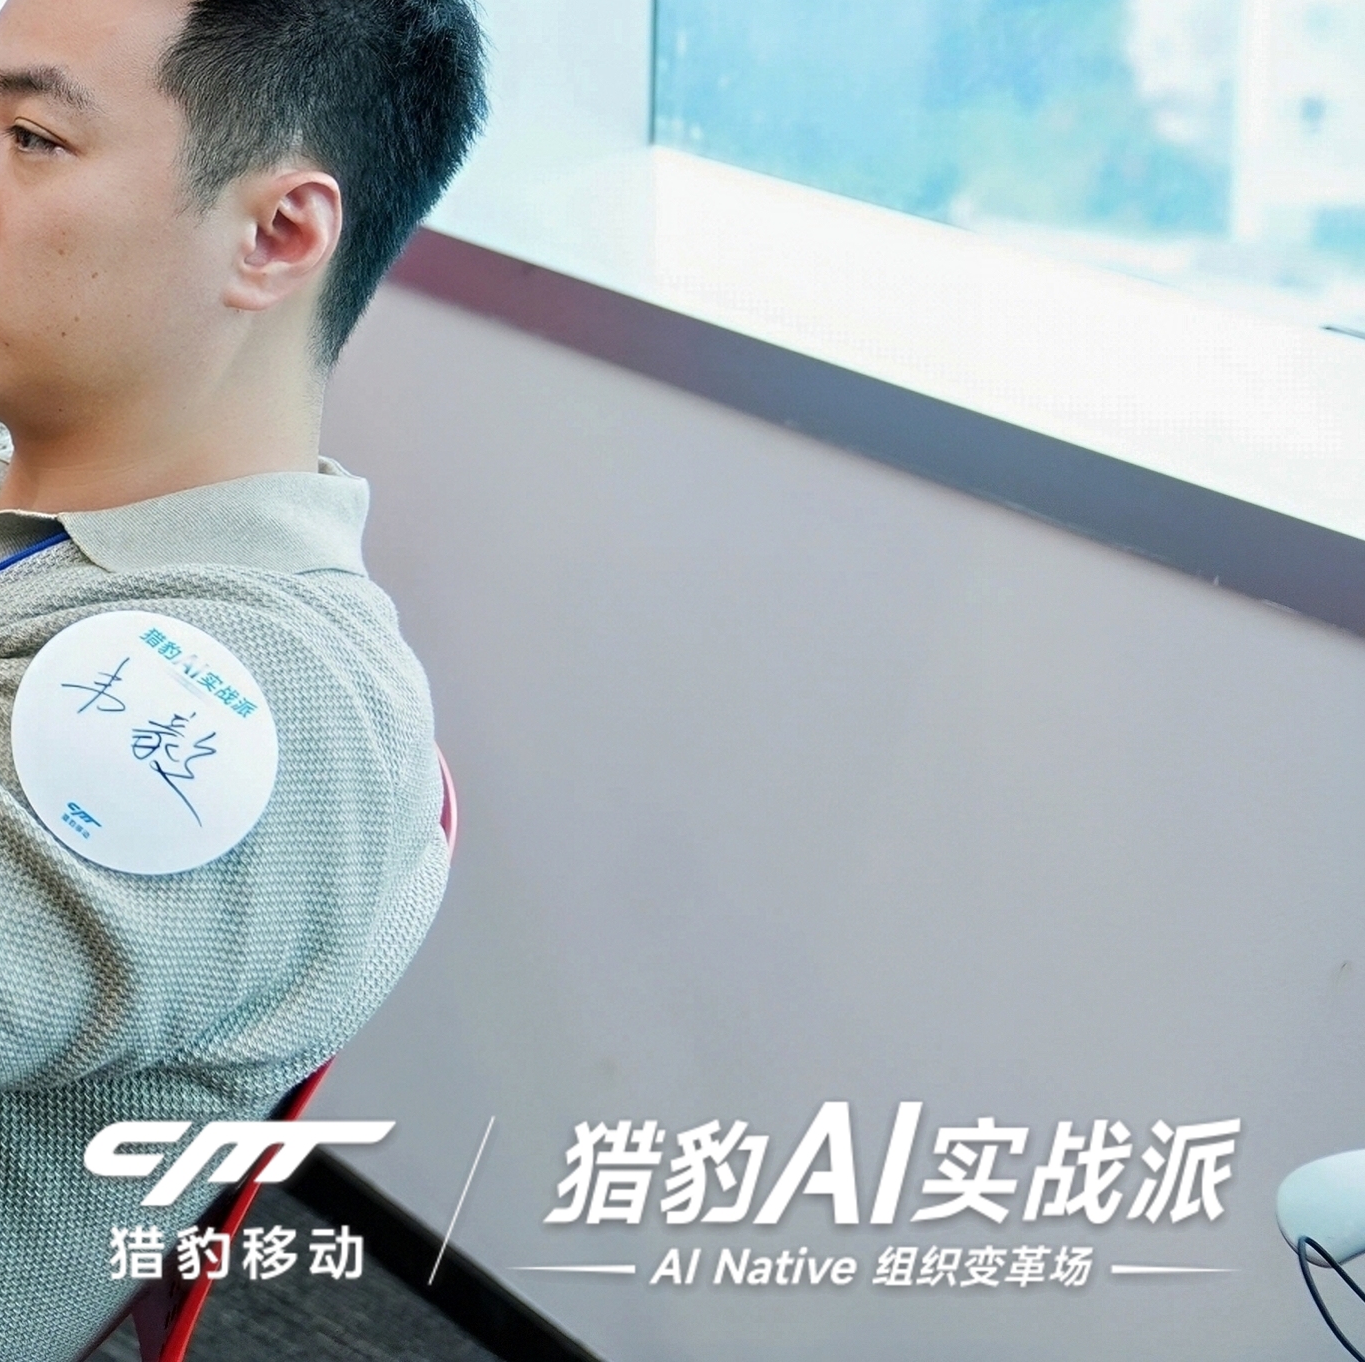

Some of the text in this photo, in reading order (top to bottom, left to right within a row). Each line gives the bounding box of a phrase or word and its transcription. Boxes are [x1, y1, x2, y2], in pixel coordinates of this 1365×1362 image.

[139, 627, 258, 718] 猎豹AI实战派
